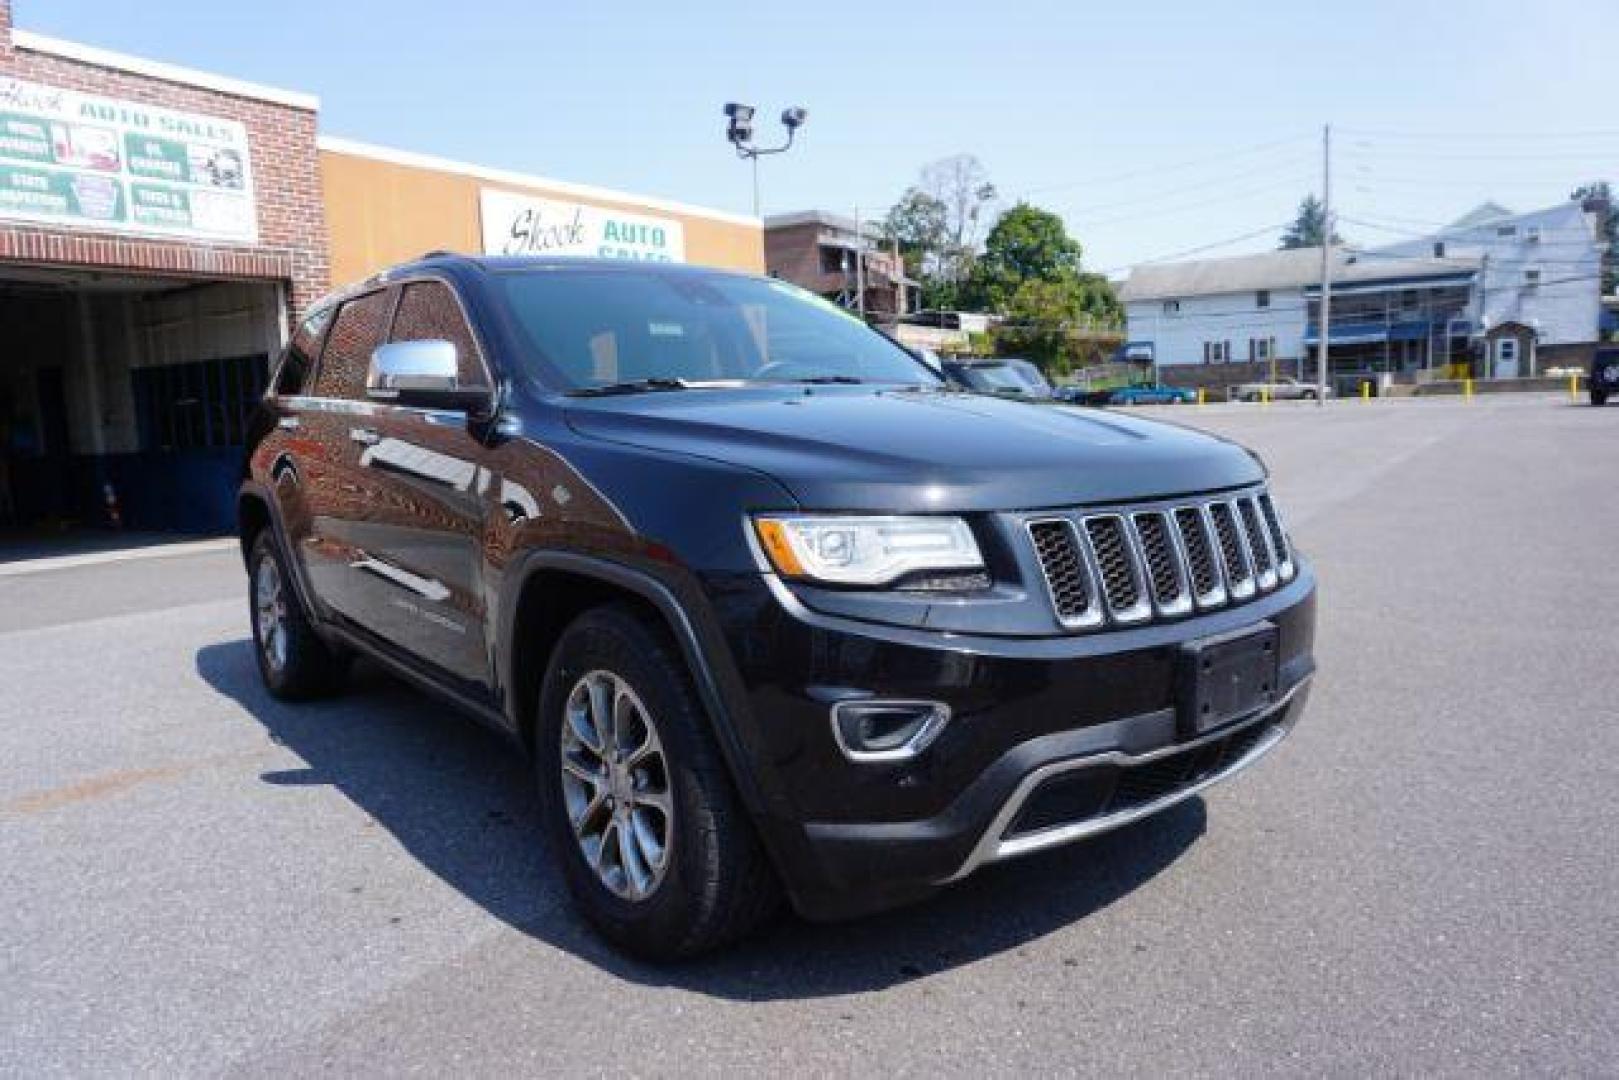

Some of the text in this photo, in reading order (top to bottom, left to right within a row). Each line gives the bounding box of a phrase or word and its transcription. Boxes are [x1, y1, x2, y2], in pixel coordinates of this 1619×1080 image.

[80, 101, 150, 128] AUTO
[159, 116, 235, 142] SALES
[604, 220, 666, 248] AUTO
